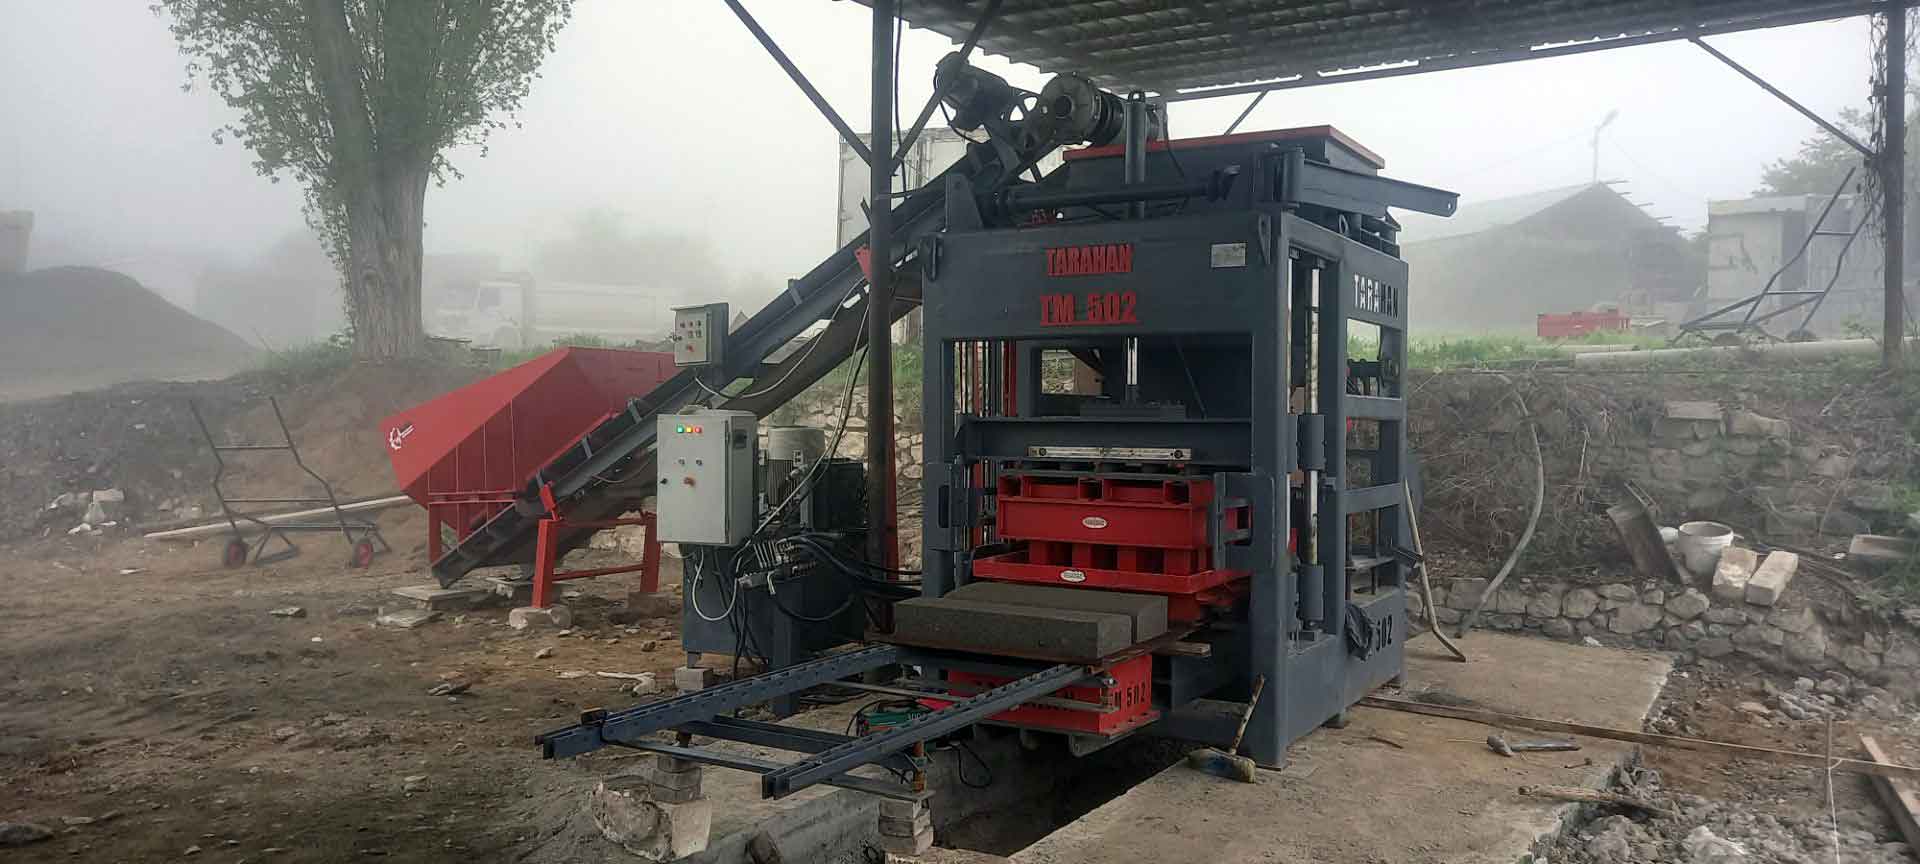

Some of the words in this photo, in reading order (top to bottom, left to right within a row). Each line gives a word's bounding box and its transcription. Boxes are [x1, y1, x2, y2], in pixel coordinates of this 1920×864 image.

[1046, 245, 1134, 276] TARAHAN
[1040, 294, 1075, 326] TM
[1087, 291, 1137, 323] 502
[1354, 273, 1398, 319] TARAHAN
[1127, 682, 1146, 707] 502
